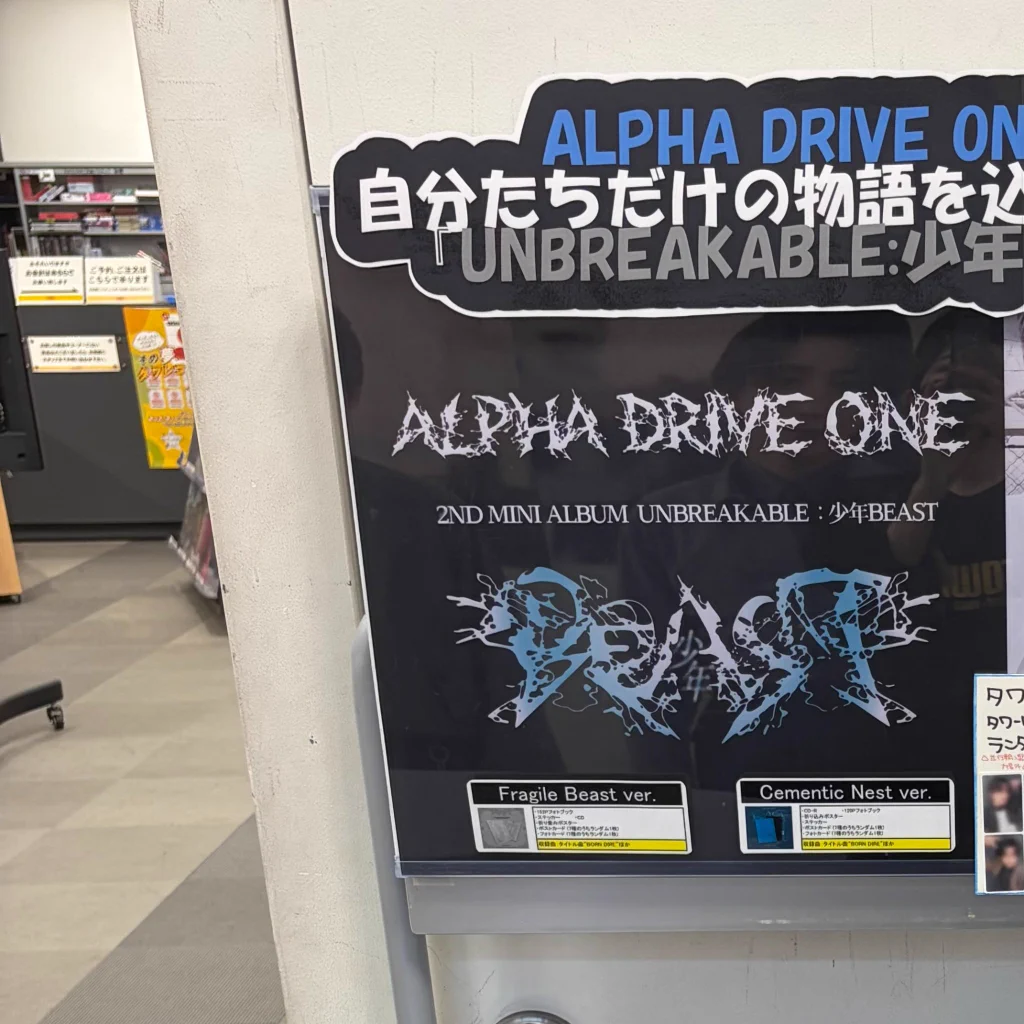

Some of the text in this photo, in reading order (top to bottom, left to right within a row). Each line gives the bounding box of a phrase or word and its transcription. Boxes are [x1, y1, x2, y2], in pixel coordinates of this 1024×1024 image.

[542, 107, 739, 165] ALPHA
[763, 106, 929, 163] DRIVE
[391, 386, 975, 460] ALPHA DRIVE ONE
[436, 501, 939, 524] 2ND MINI ALBUM UNBREAKABLE 少年BEAST
[499, 786, 656, 804] Fragile Beast ver.
[760, 784, 931, 800] Cementic Nest ver.
